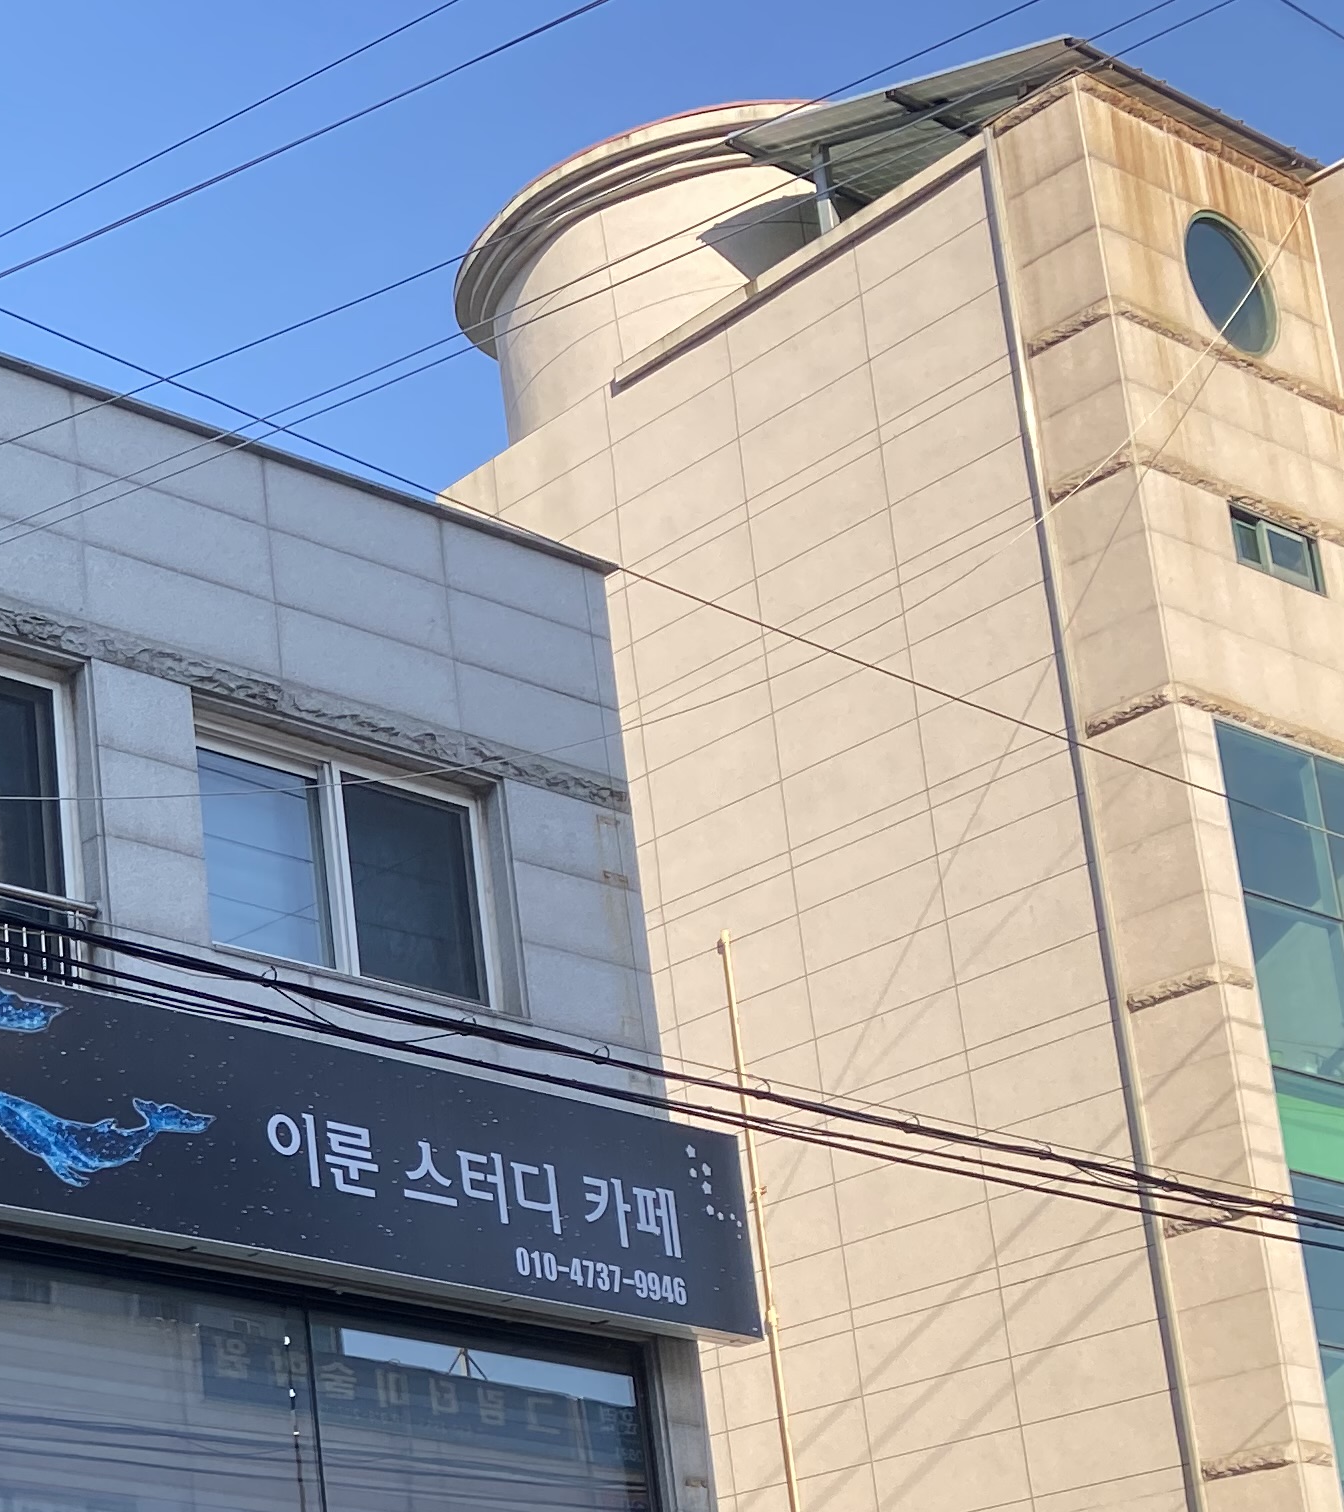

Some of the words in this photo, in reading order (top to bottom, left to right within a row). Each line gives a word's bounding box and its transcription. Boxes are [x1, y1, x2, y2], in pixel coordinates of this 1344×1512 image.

[266, 1111, 380, 1199] 이룬
[403, 1139, 564, 1236] 스터디
[582, 1175, 683, 1259] 카페
[514, 1246, 688, 1306] 010-4737-9946
